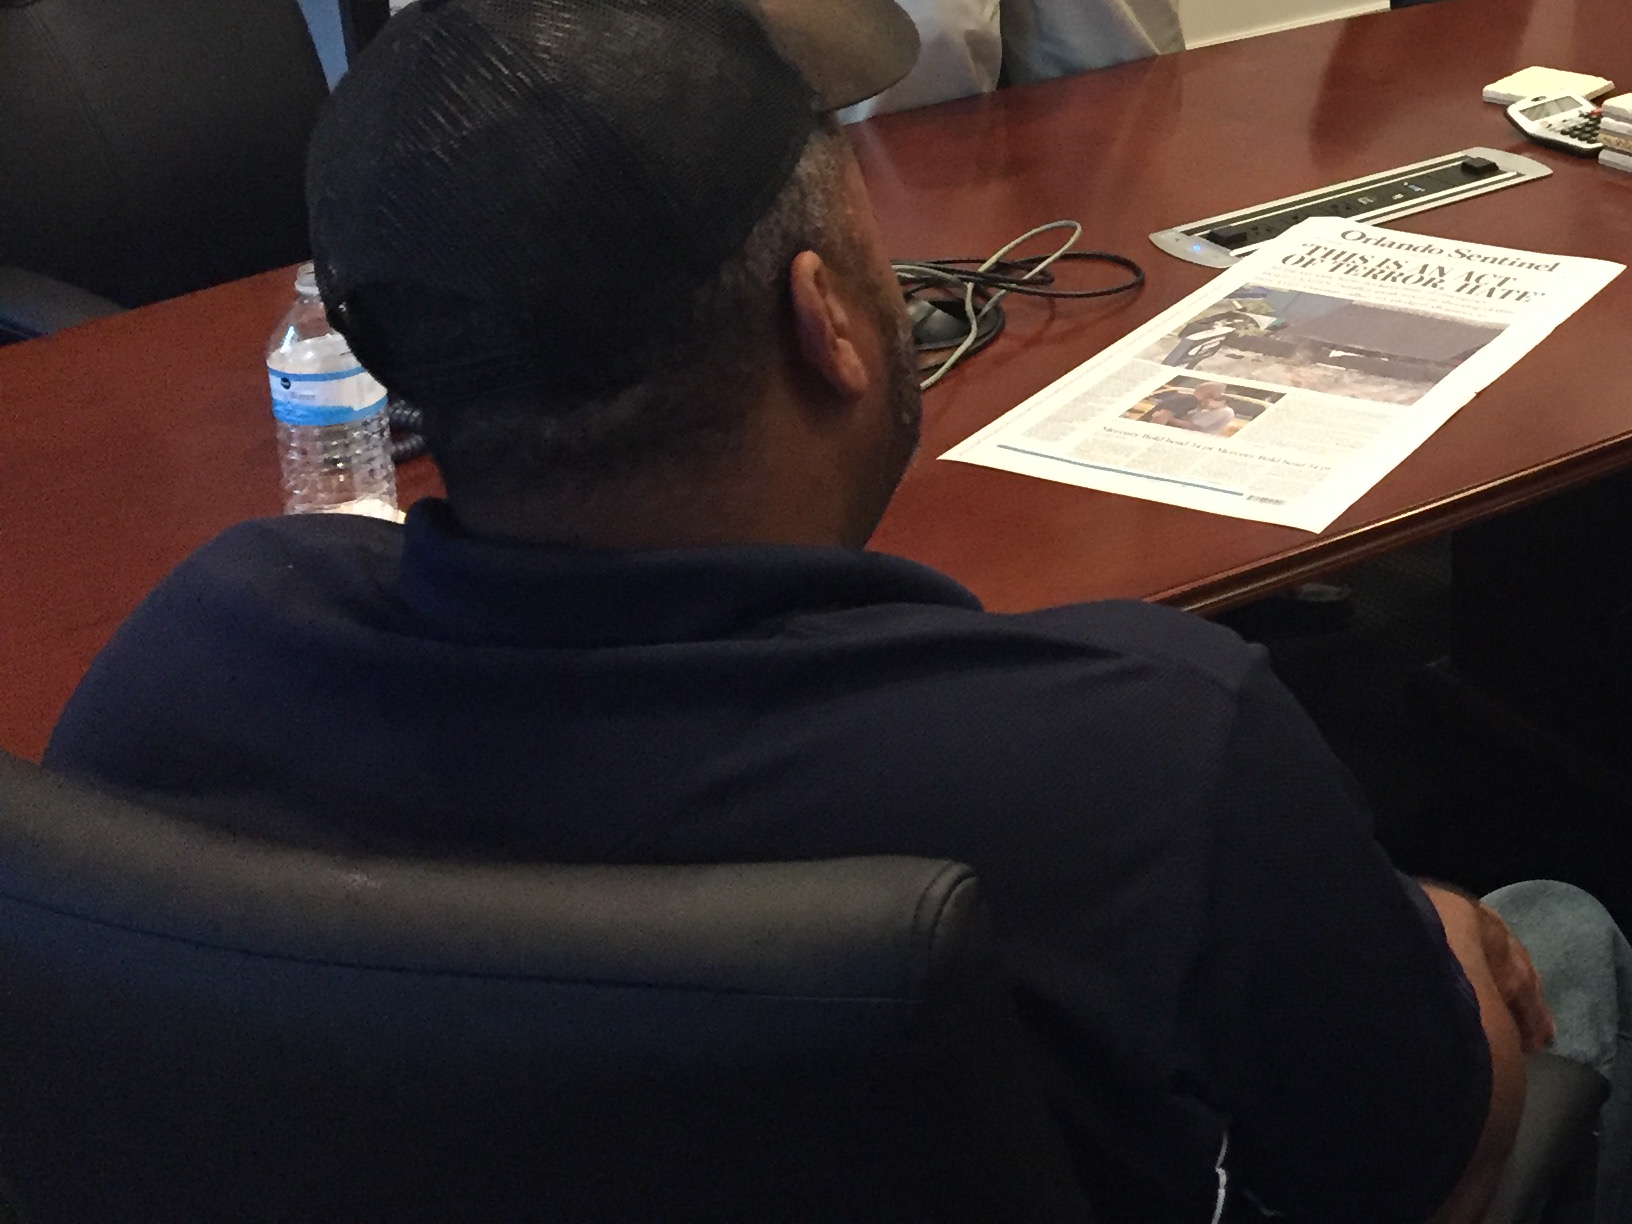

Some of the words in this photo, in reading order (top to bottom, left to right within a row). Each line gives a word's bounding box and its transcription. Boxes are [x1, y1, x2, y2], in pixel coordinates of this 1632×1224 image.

[1281, 254, 1324, 269] OF
[1341, 229, 1444, 255] Orlando
[1447, 248, 1561, 272] Sentinel
[1375, 257, 1408, 271] IS
[1406, 263, 1454, 278] AN
[1453, 270, 1517, 287] ACT
